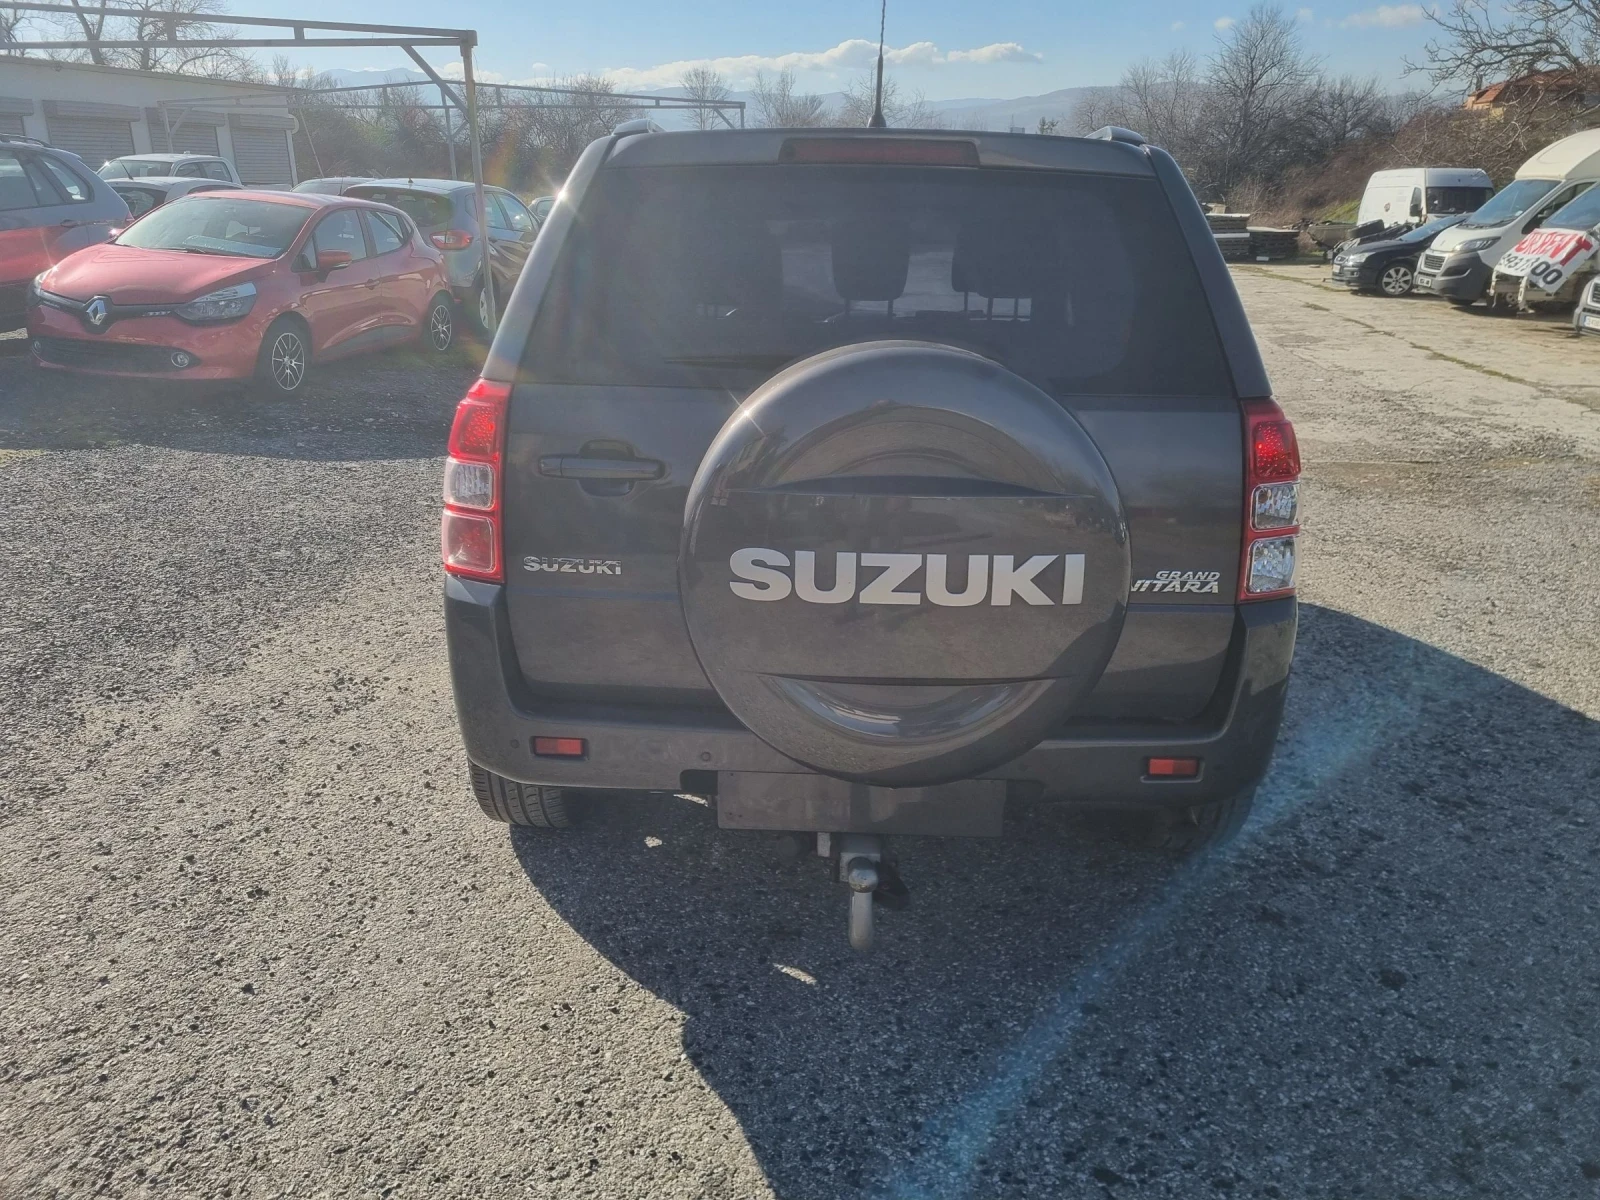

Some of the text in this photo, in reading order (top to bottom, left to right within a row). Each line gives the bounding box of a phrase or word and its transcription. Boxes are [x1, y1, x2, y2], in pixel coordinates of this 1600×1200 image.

[523, 556, 622, 575] SUZUKI
[729, 547, 1085, 606] SUZUKI
[1156, 570, 1220, 581] GRAND
